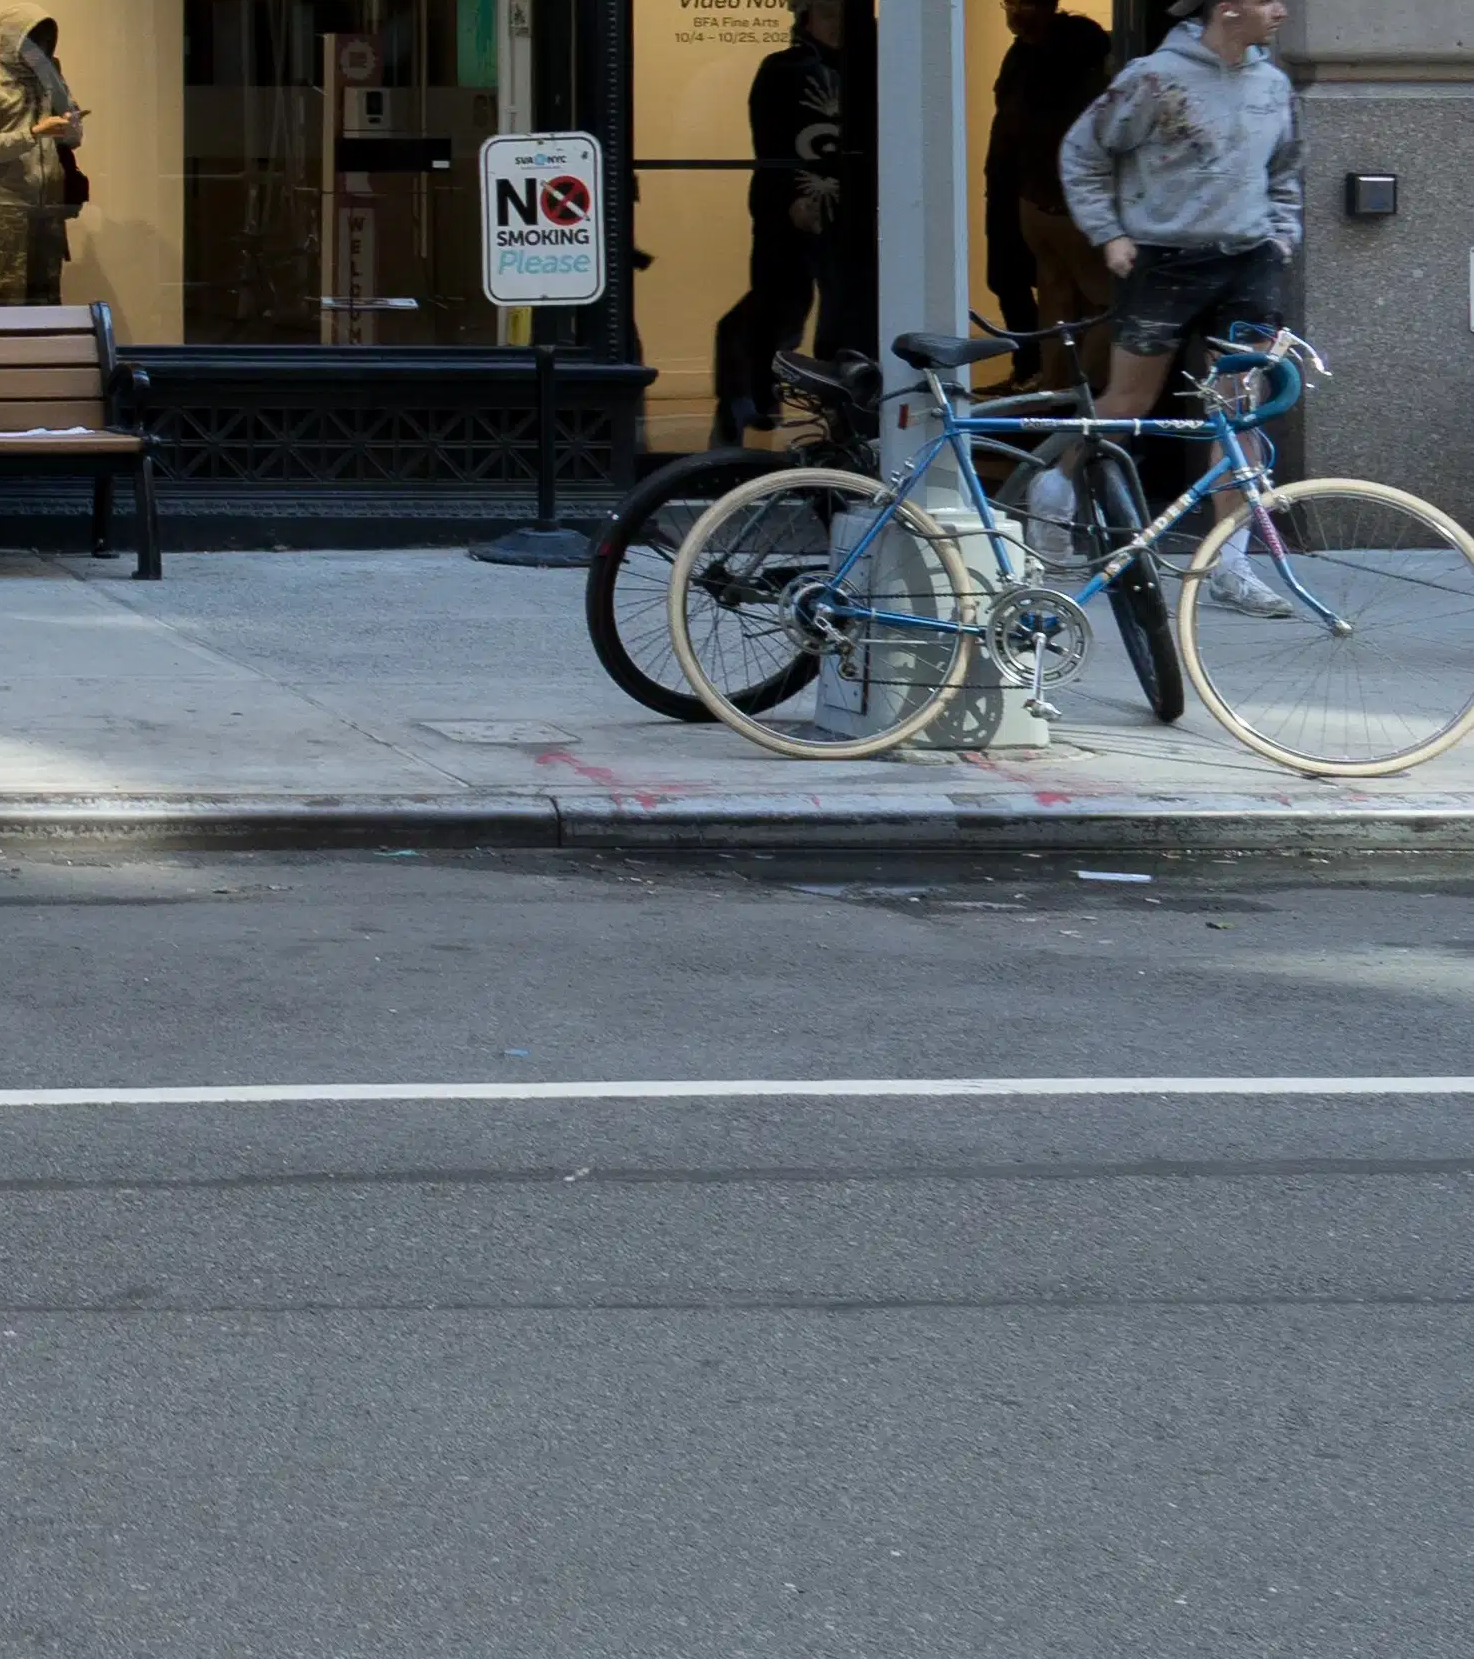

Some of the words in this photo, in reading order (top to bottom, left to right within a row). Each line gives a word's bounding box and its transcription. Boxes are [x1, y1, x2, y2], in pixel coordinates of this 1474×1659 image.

[722, 17, 749, 28] Fine
[752, 17, 780, 28] Arts
[763, 32, 793, 43] 202
[547, 154, 567, 164] NYC
[497, 228, 590, 247] SMOKING
[498, 249, 591, 276] Please
